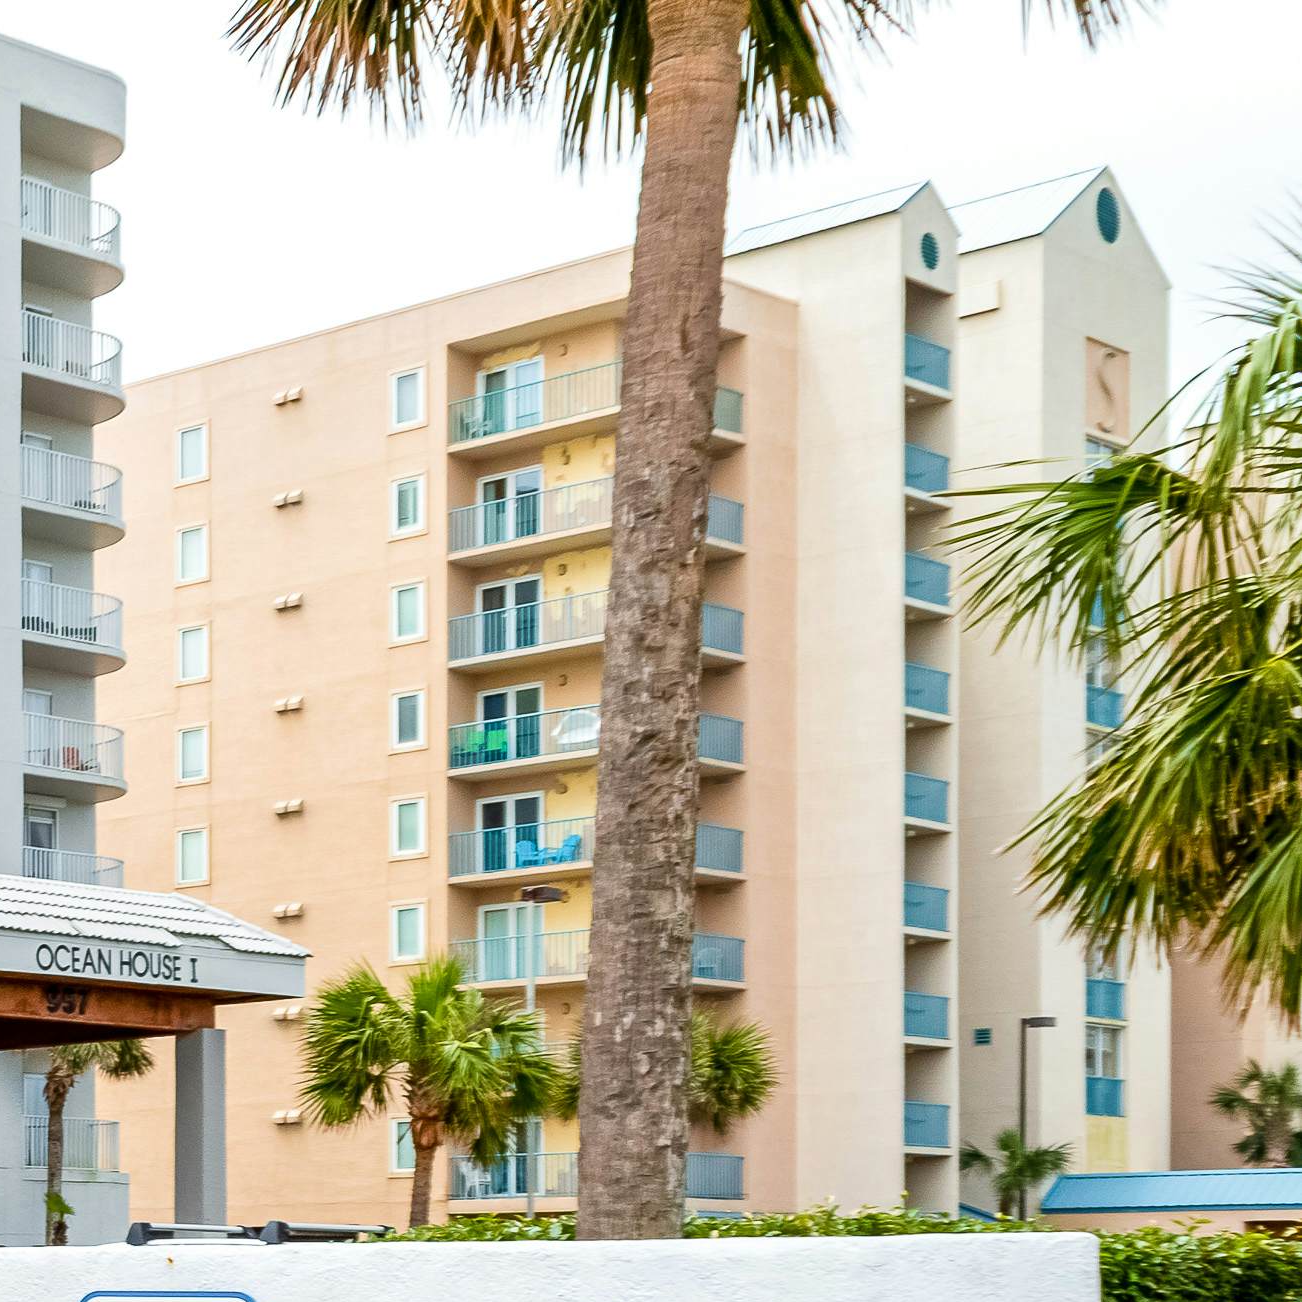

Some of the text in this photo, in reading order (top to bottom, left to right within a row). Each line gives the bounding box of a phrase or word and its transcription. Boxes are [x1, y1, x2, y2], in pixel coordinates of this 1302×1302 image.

[36, 943, 198, 982] OCEAN HOUSE I
